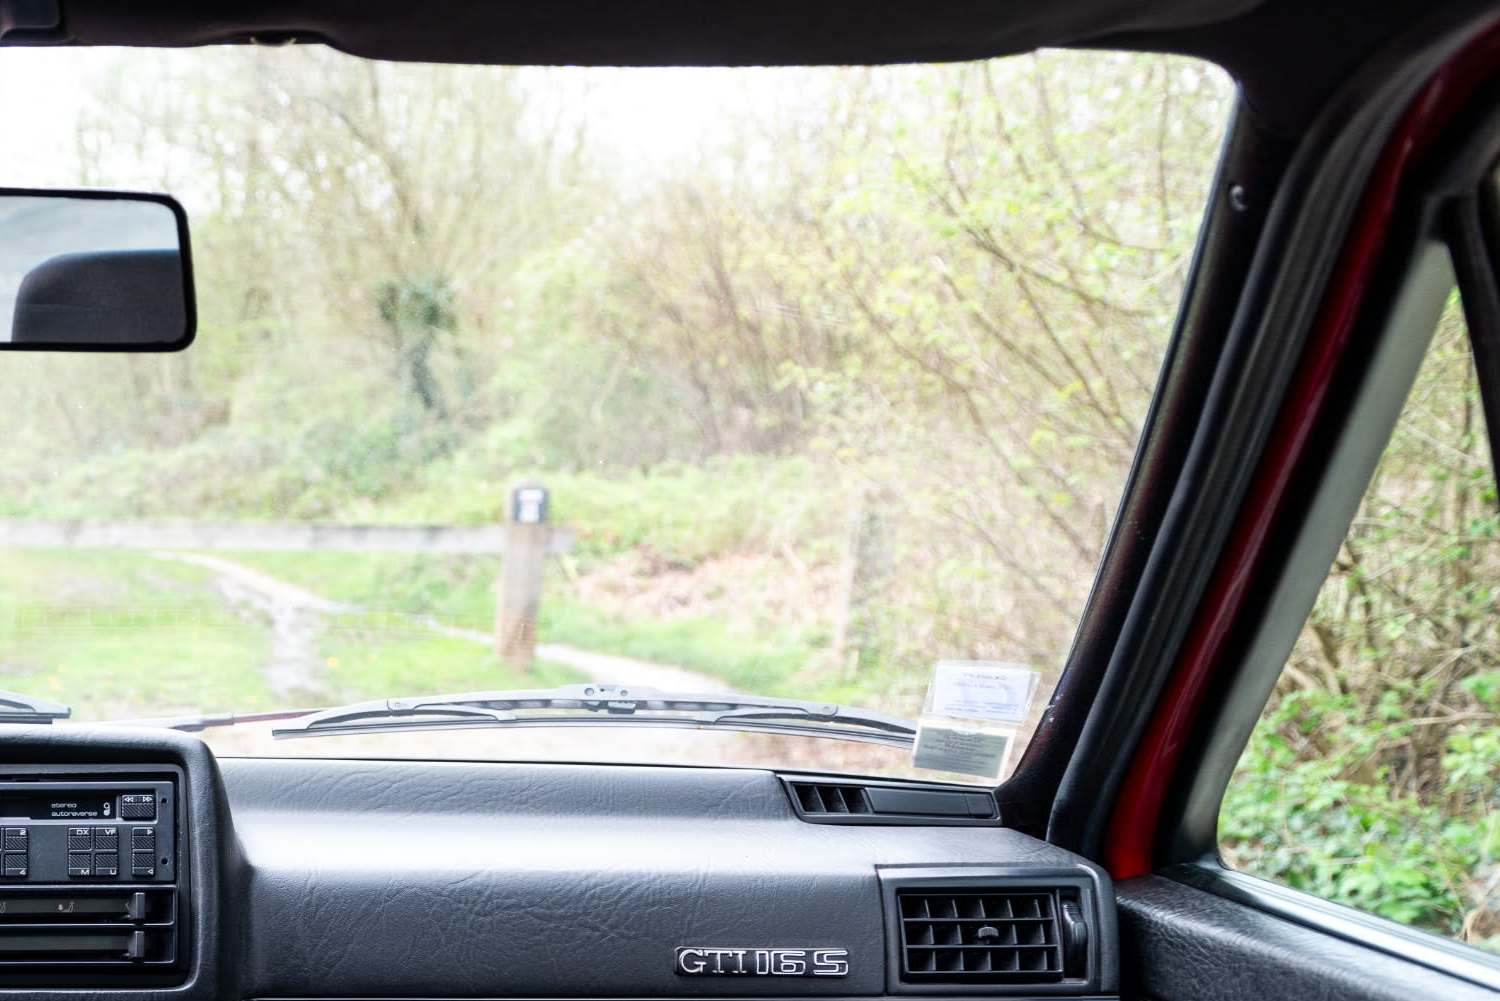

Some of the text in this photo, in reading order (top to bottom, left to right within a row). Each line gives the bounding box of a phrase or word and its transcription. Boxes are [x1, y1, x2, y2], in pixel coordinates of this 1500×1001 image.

[678, 949, 849, 976] GTI 16 S
